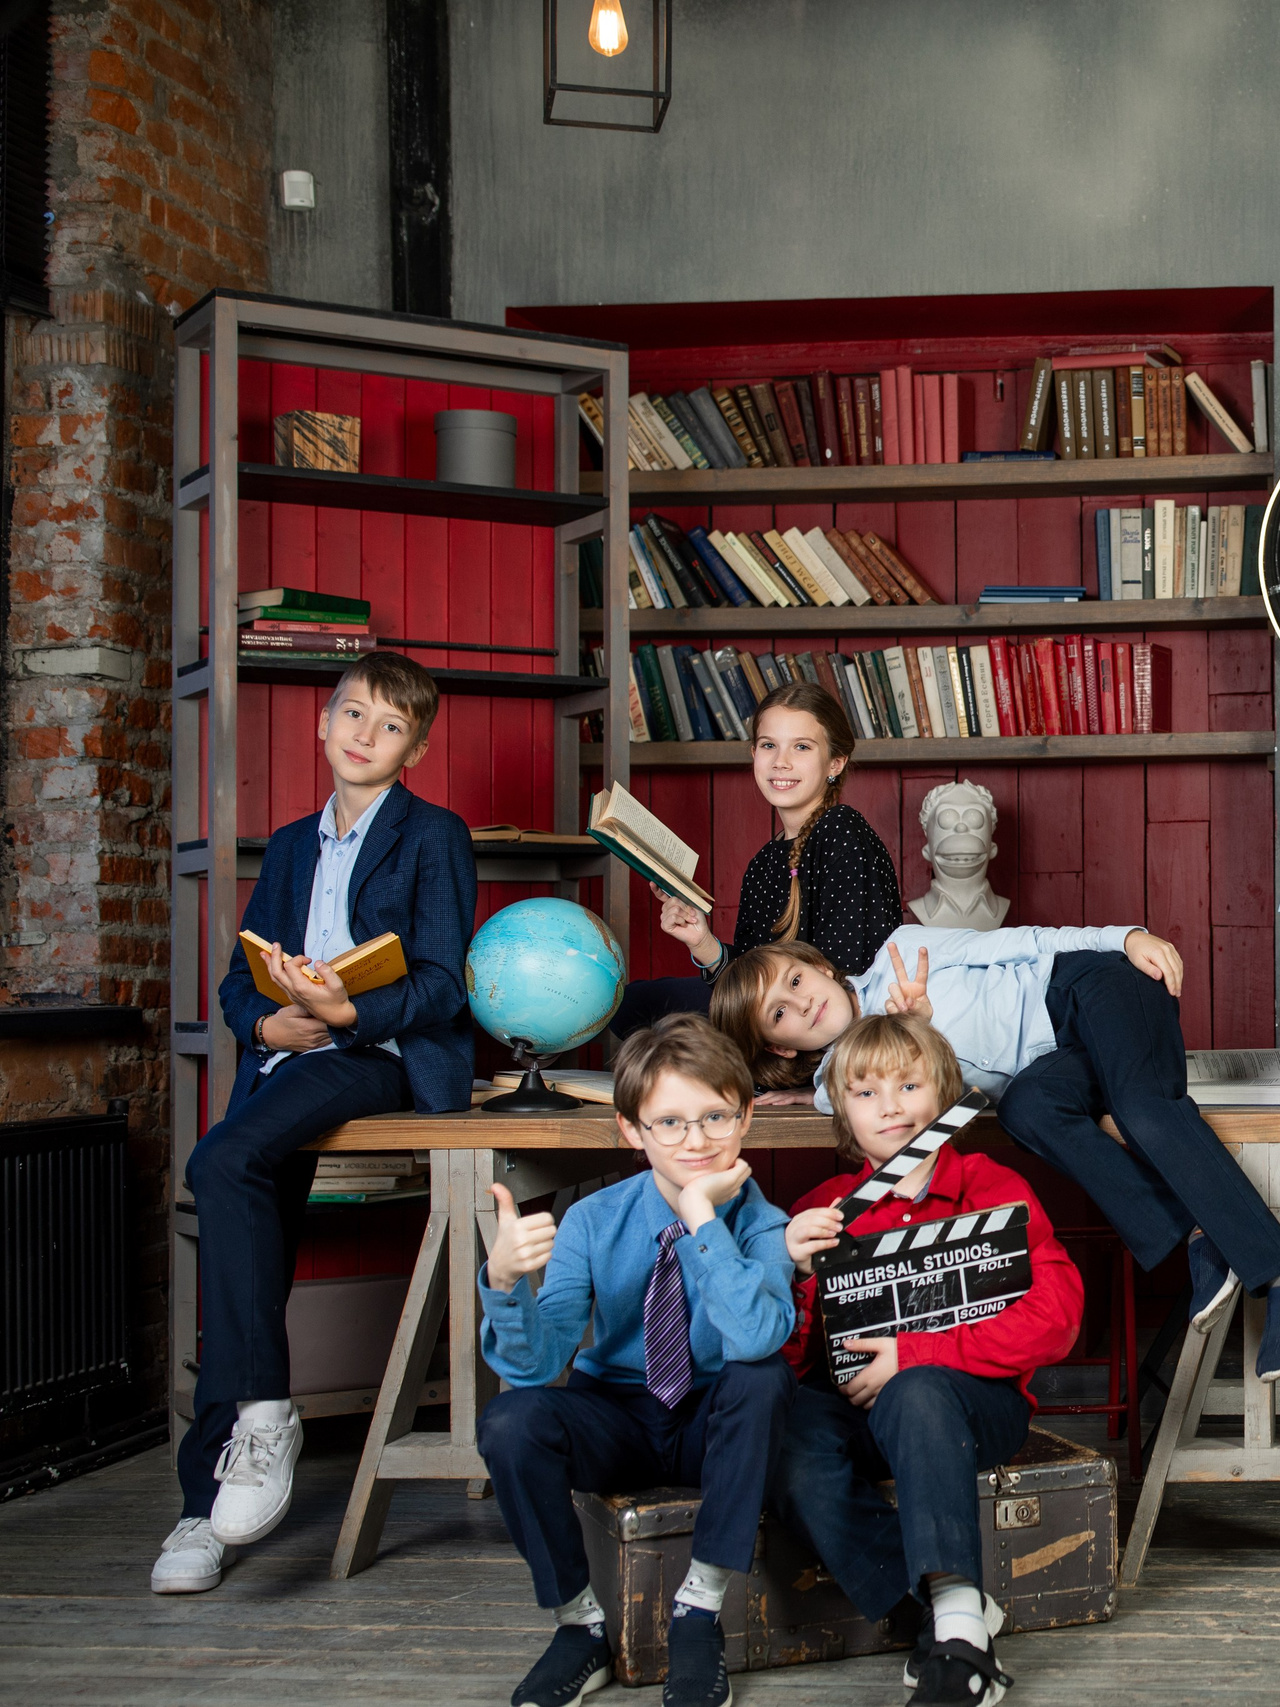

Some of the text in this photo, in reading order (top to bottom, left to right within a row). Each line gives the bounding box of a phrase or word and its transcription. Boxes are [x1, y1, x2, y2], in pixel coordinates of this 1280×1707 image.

[774, 540, 818, 594] ГРЭМ ГРИН
[979, 662, 993, 729] Сергей Есенин
[826, 1259, 917, 1292] UNIVERSAL
[978, 1258, 1013, 1274] ROLL
[909, 1272, 944, 1289] TAKE
[838, 1286, 883, 1305] SCENE
[959, 1300, 1007, 1320] SOUND
